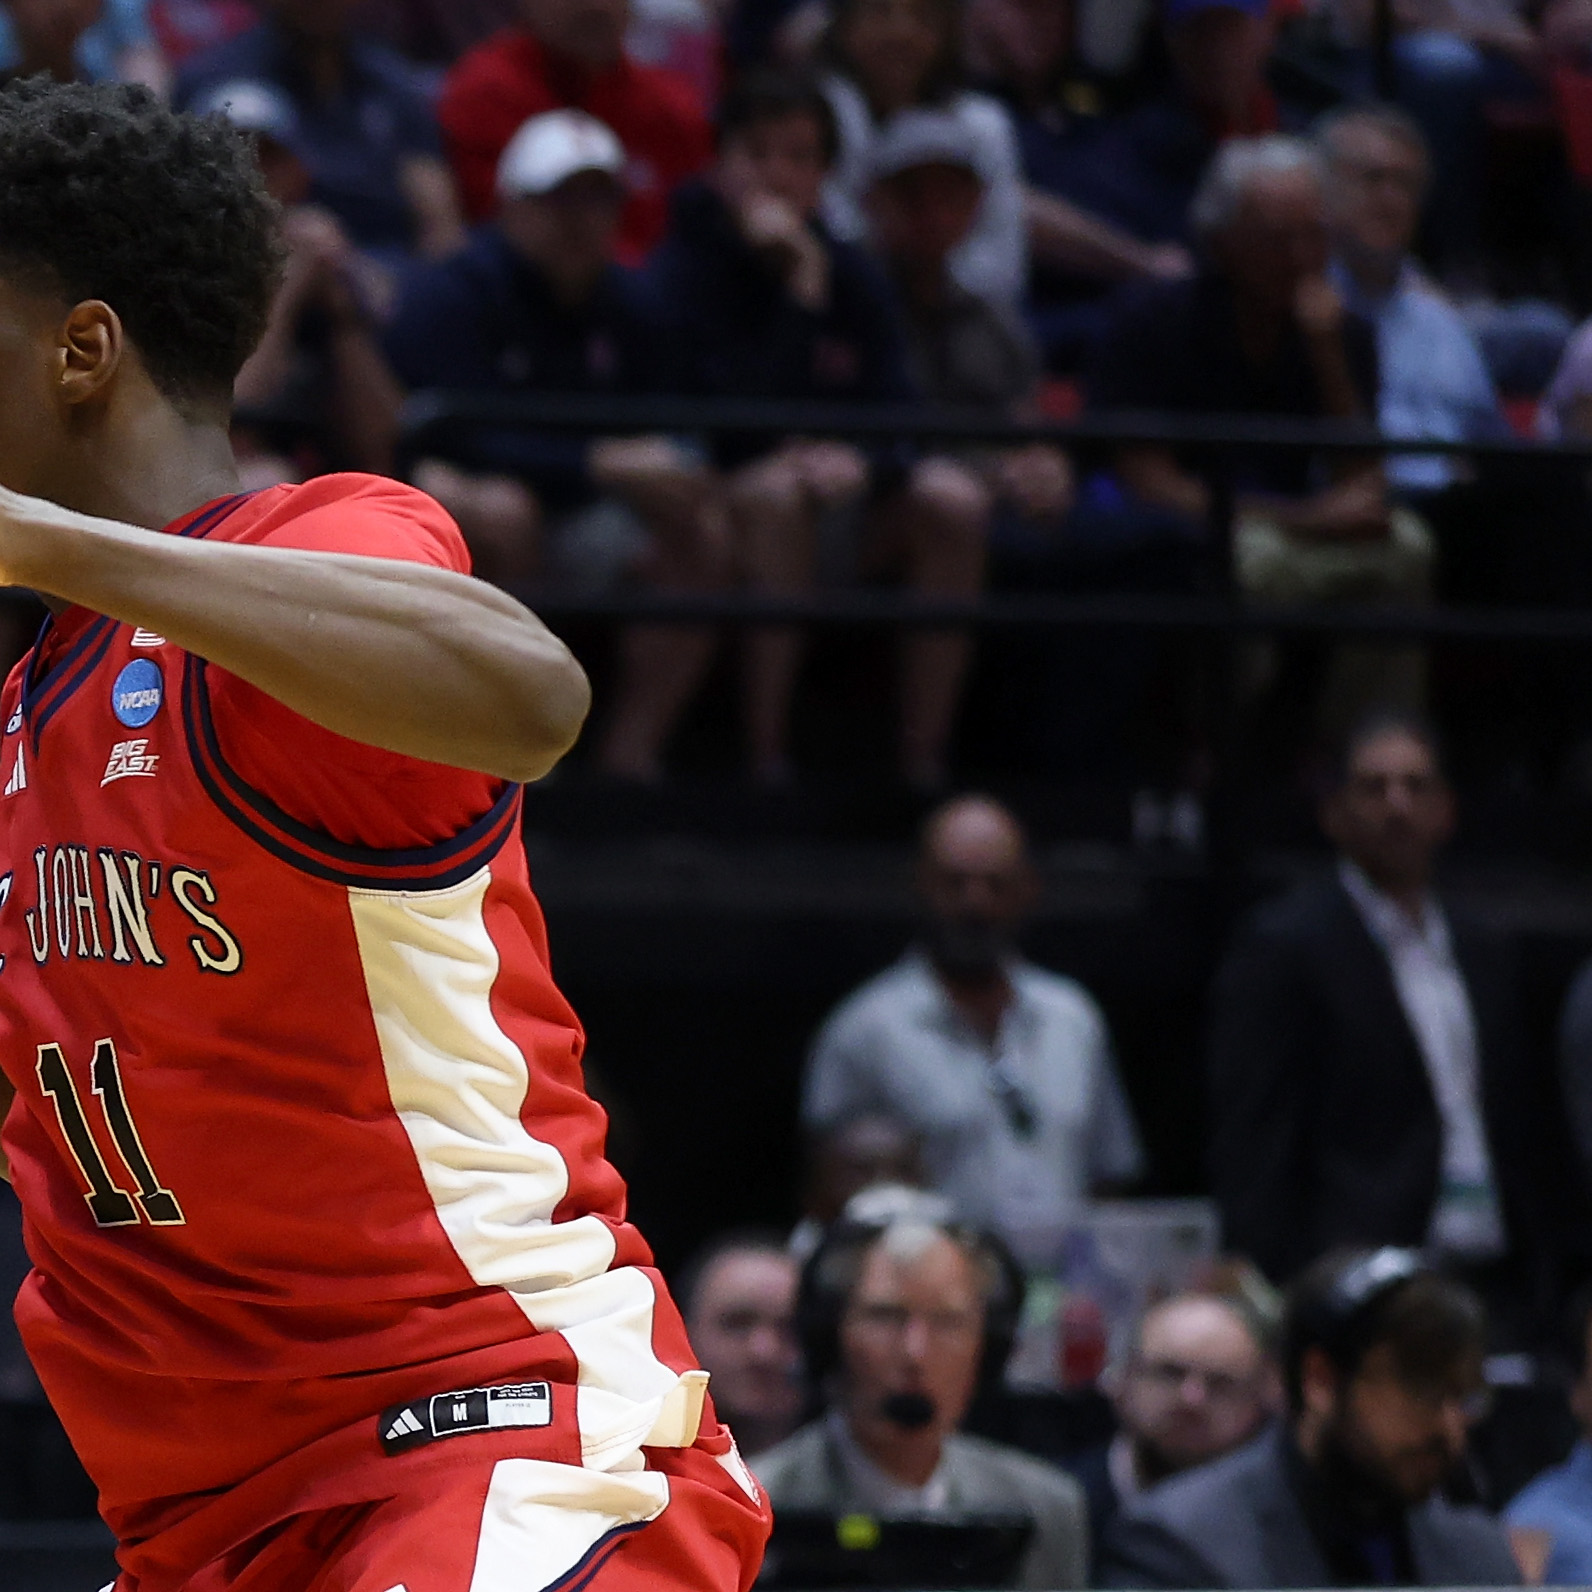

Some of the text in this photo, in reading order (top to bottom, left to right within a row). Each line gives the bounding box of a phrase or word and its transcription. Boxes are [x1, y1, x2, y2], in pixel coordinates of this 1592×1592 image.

[119, 688, 160, 710] NCAA
[111, 739, 149, 760] BIG
[104, 755, 160, 777] EAST
[25, 845, 243, 975] JOHN'S
[34, 1036, 187, 1228] 11
[452, 1403, 468, 1422] M
